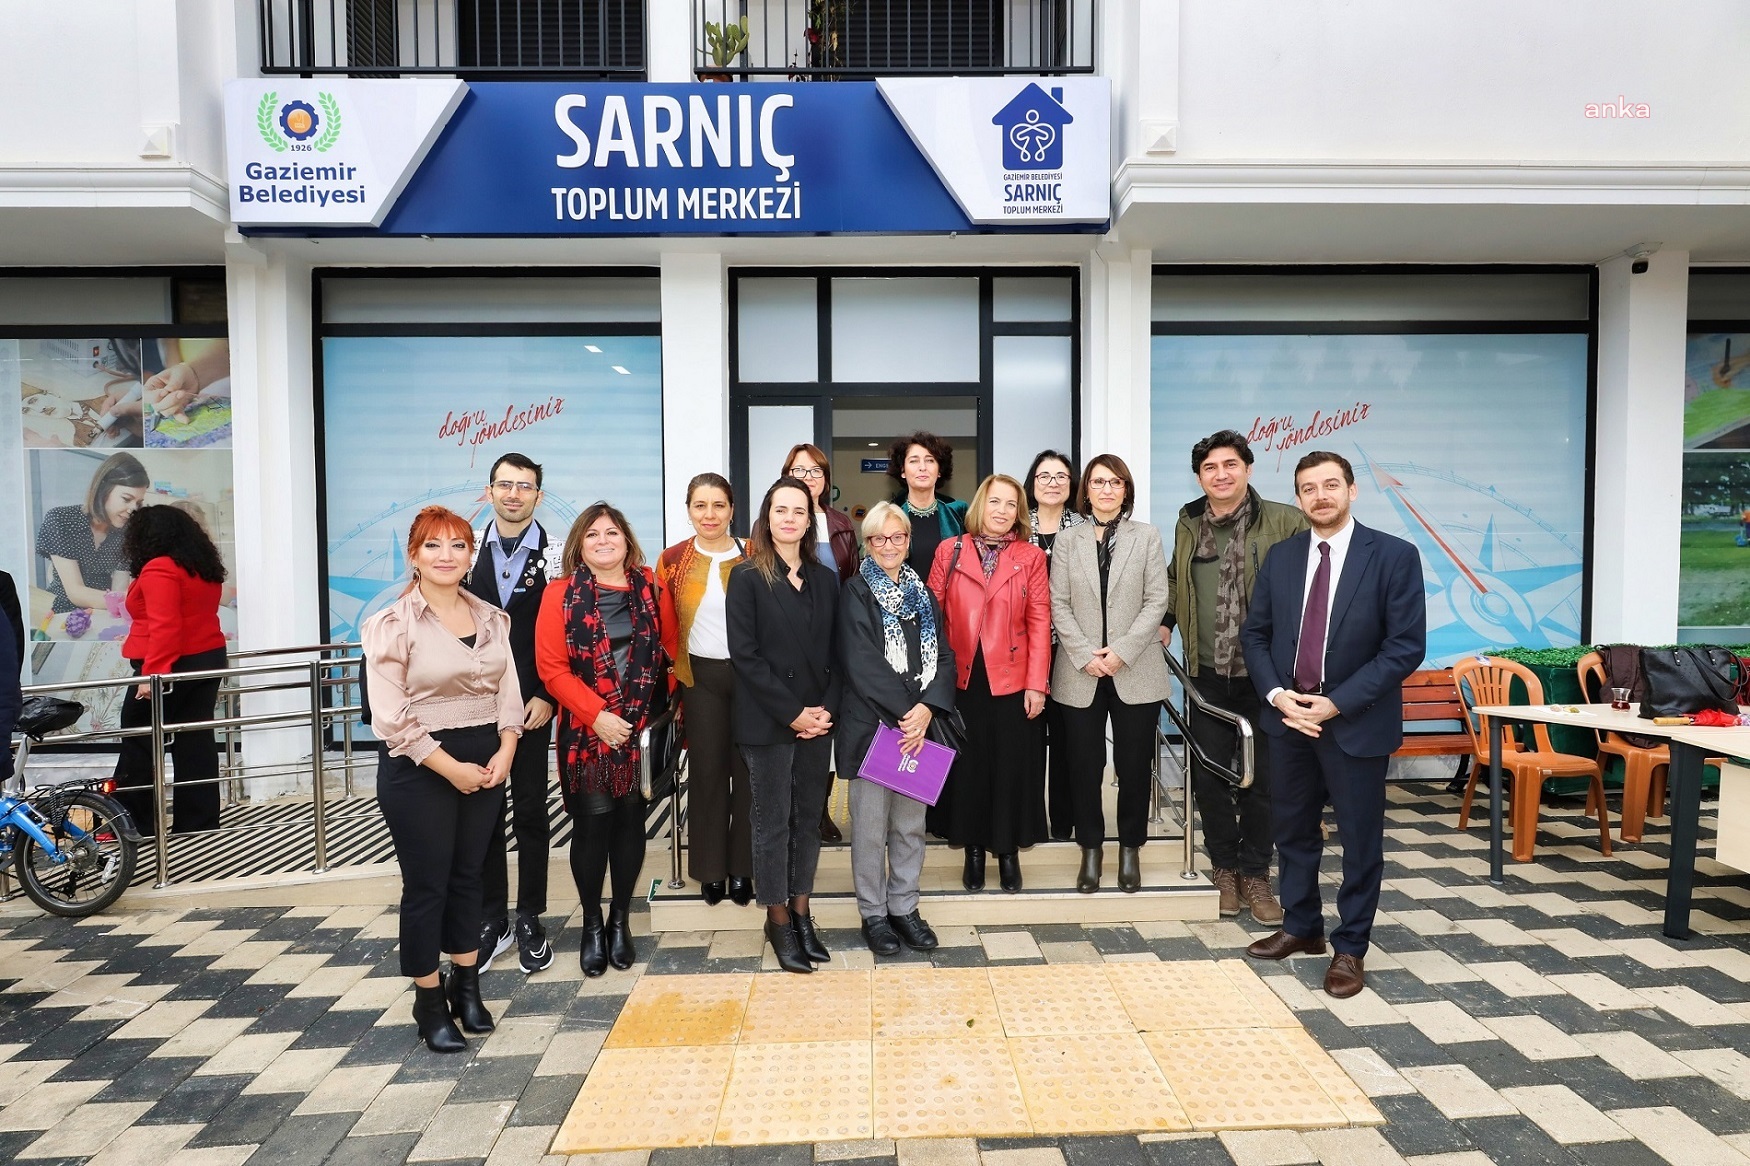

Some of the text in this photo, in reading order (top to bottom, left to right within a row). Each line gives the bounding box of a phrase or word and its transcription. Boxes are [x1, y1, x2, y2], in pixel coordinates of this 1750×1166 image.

[290, 144, 312, 152] 1926
[554, 94, 795, 183] SARNIÇ
[245, 162, 357, 181] Gaziemir
[1003, 172, 1063, 181] GAZİEMİR BELEDİYESİ
[238, 184, 366, 208] Belediyesi
[551, 182, 801, 220] TOPLUM MERKEZİ
[1003, 203, 1064, 215] TOPLUM MERKEZİ
[1004, 183, 1062, 205] SARNIÇ
[438, 410, 488, 447] doğru
[469, 396, 566, 469] yöndesiniz
[1245, 415, 1295, 452] doğru
[1276, 401, 1372, 474] yöndesiniz
